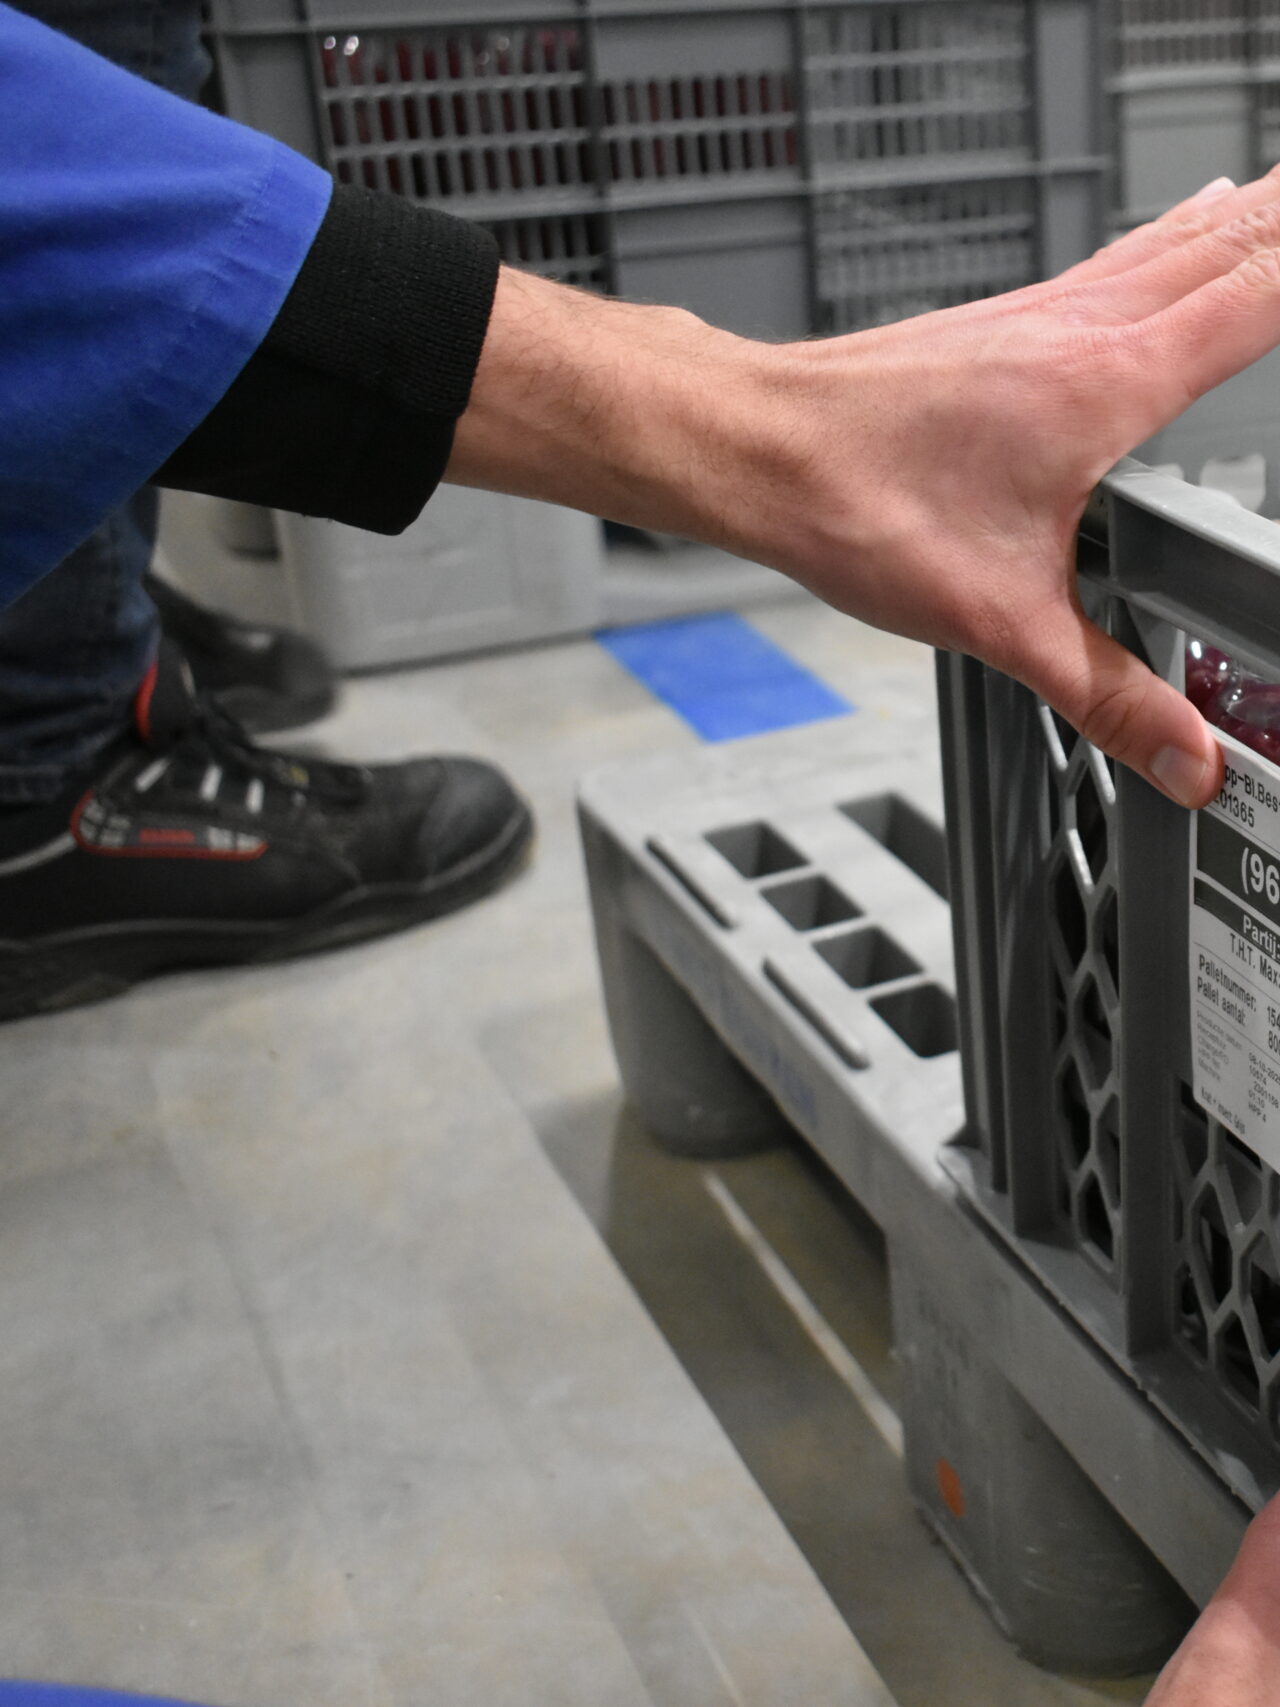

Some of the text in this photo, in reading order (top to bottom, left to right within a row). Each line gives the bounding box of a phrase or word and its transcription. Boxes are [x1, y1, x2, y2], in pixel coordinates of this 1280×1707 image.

[1215, 788, 1255, 828] 01365
[1243, 914, 1280, 960] Partij:
[1199, 953, 1257, 1013] Palletnummer:
[1230, 933, 1256, 969] T.H.T.
[1259, 954, 1280, 990] Max:
[1197, 975, 1219, 1007] Pallet
